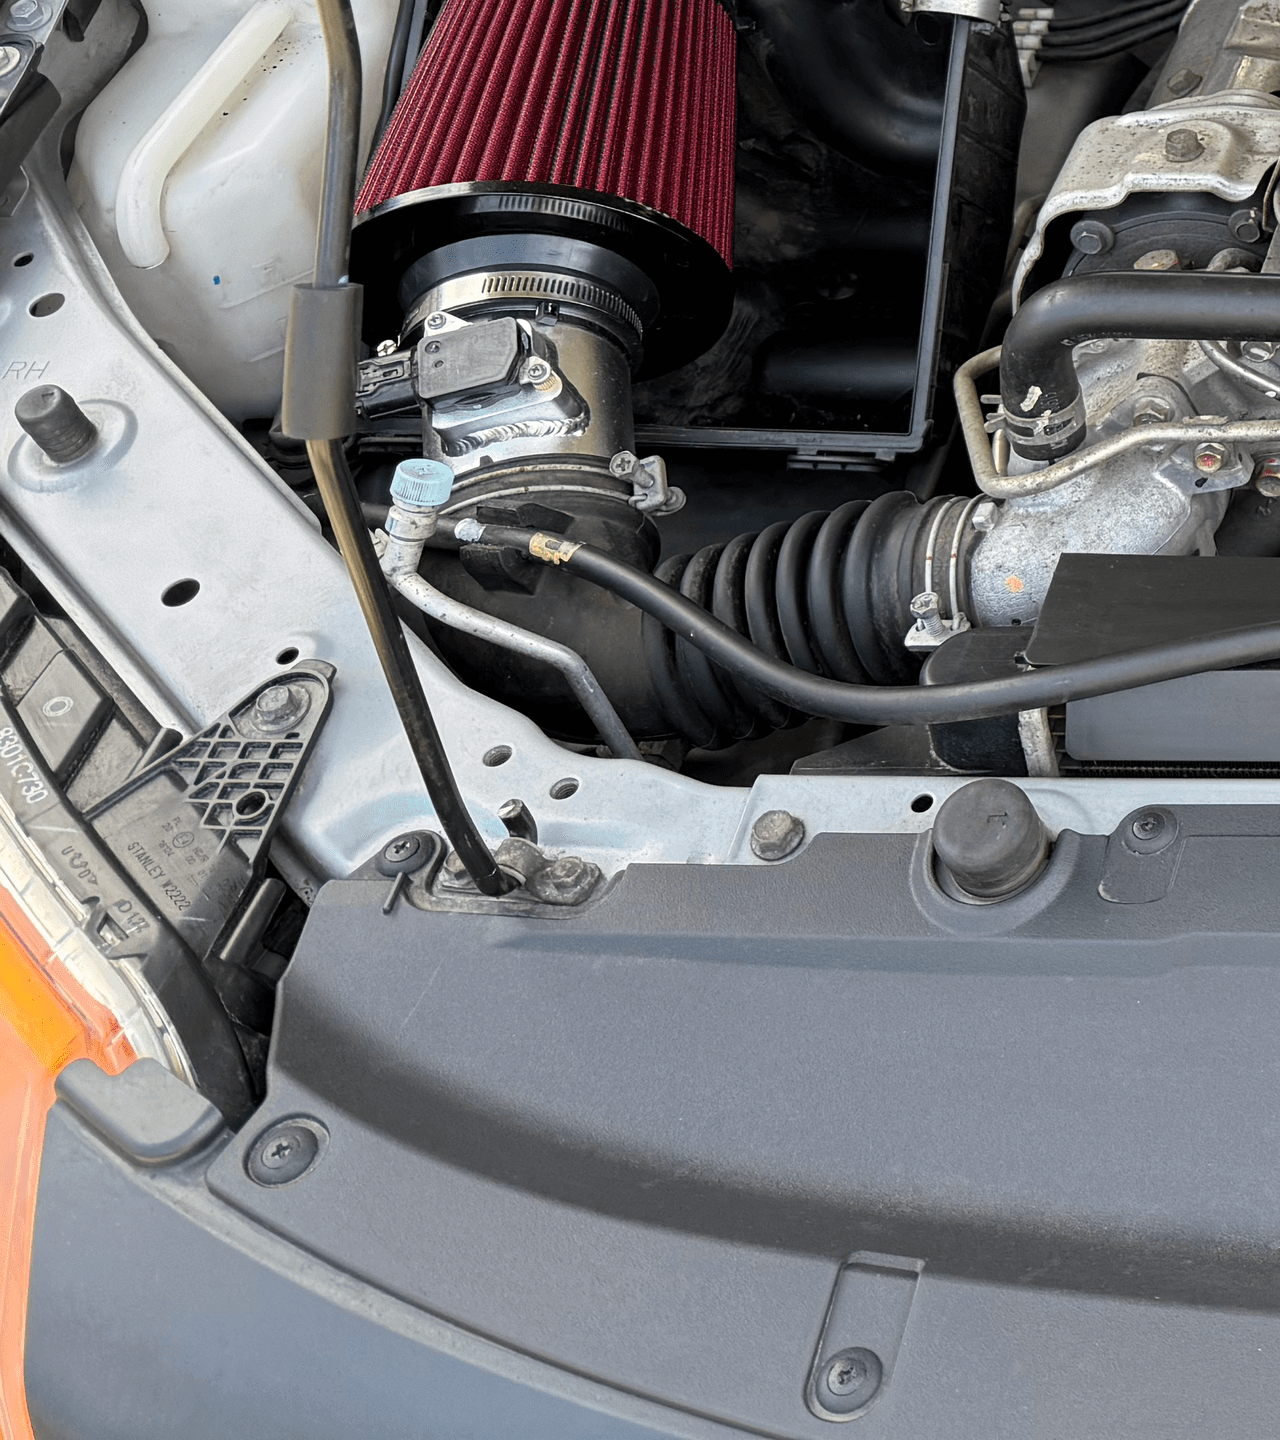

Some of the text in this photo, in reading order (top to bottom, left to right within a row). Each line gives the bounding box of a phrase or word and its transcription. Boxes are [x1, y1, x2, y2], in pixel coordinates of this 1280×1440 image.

[1, 360, 51, 379] RH
[127, 841, 166, 880] STANLEY
[161, 879, 191, 911] W2222
